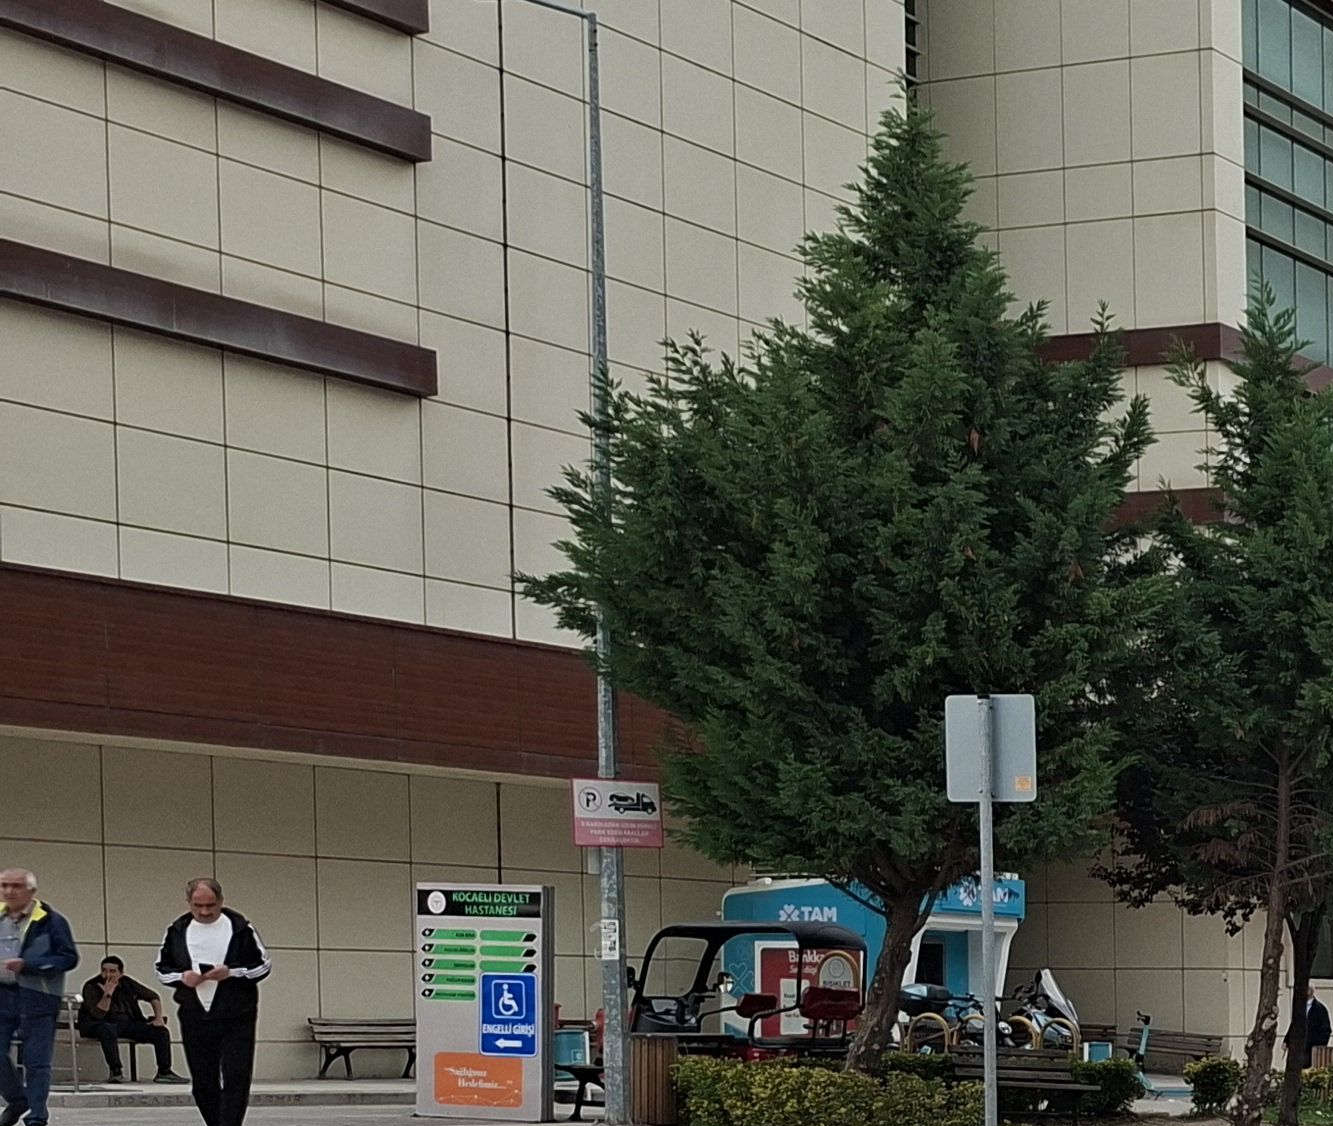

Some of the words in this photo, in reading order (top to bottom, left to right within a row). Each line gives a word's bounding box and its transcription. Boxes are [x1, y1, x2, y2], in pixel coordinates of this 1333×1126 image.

[493, 893, 531, 904] DEVLET
[801, 906, 838, 922] TAM
[482, 1022, 512, 1034] ENGELLİ
